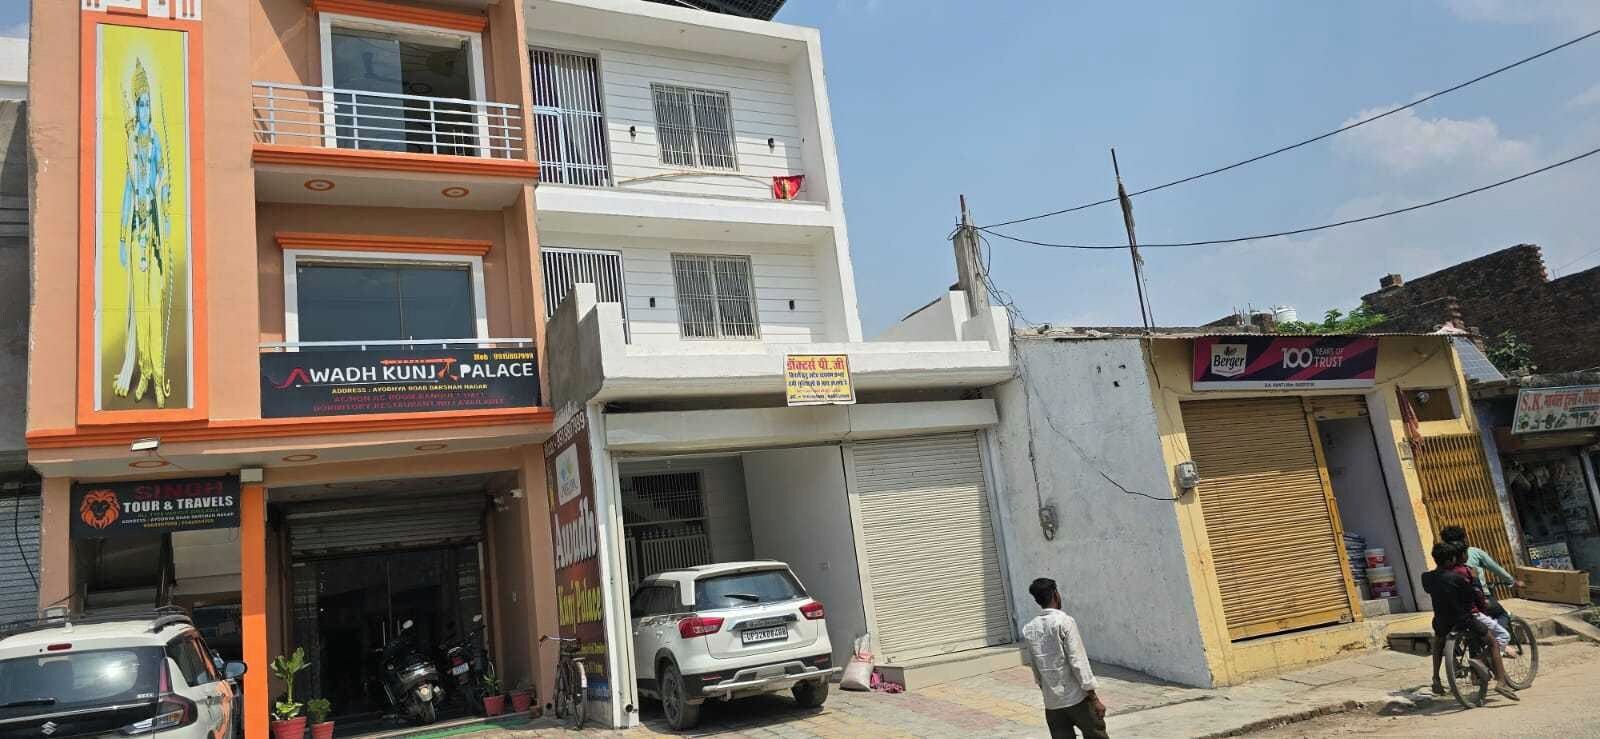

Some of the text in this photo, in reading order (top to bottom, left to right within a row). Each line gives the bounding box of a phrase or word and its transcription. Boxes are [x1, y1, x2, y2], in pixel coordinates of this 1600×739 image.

[1213, 355, 1245, 370] Berger
[1281, 347, 1313, 368] 100
[1313, 356, 1344, 368] TRUST
[383, 364, 436, 381] KUNJ
[459, 362, 534, 379] PALACE
[134, 481, 223, 499] SINGH
[123, 500, 160, 513] TOUR
[163, 500, 173, 511] &
[176, 495, 233, 509] TRAVELS
[555, 496, 597, 570] Awadh
[574, 578, 601, 623] Palace
